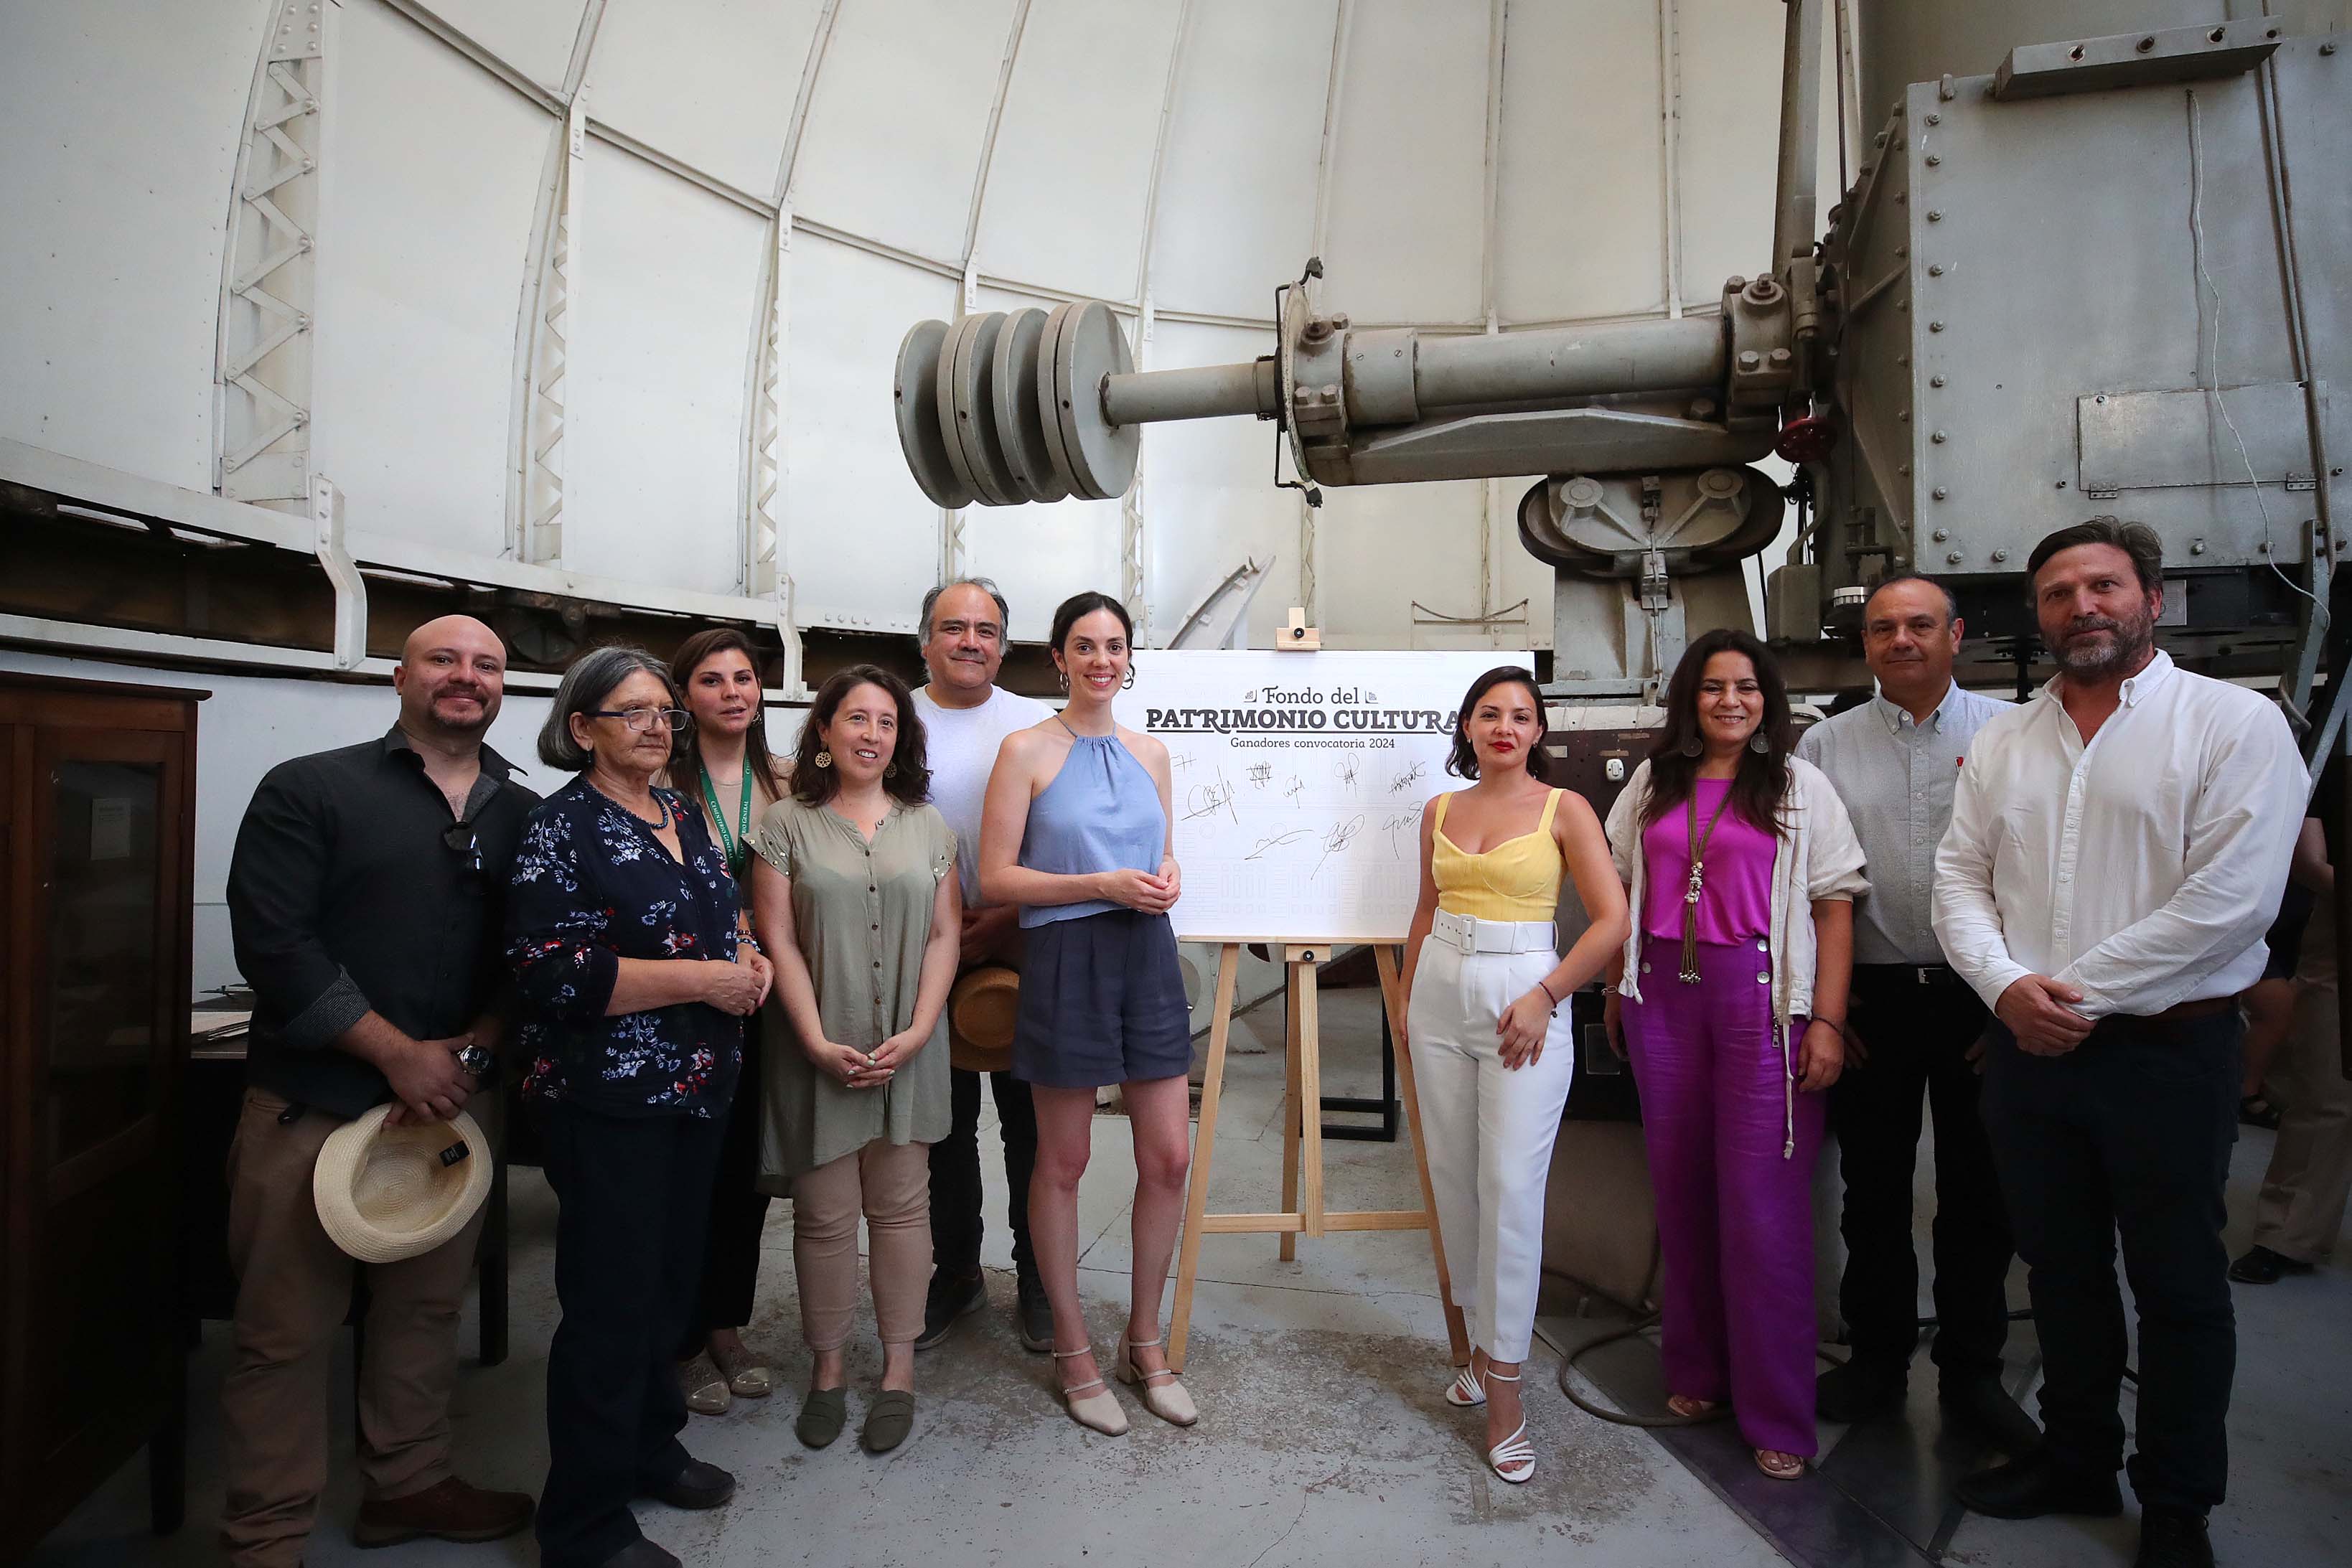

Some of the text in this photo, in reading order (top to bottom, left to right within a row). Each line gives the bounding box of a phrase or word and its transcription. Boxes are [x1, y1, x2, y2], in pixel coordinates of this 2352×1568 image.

[1262, 685, 1360, 705] Fondo del
[1146, 708, 1458, 736] PATRIMONIO CULTURA
[1230, 737, 1395, 748] Ganadores convocatoria 2024
